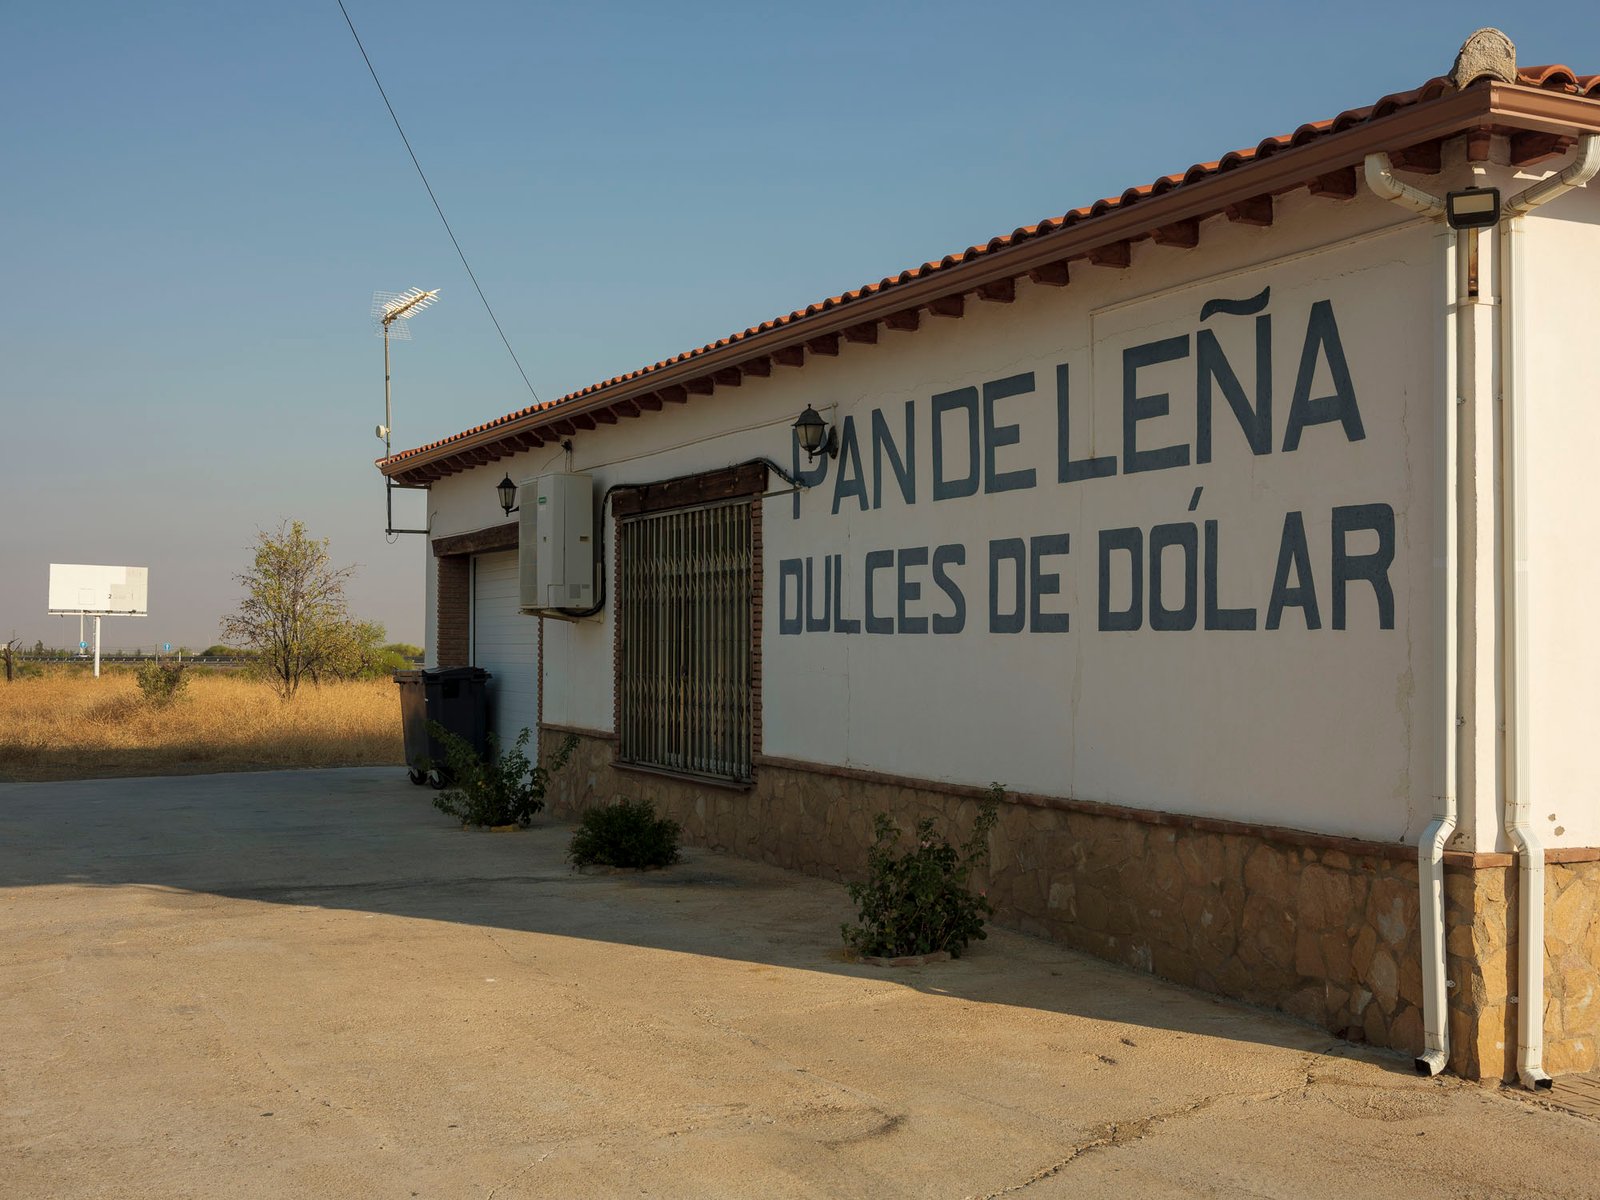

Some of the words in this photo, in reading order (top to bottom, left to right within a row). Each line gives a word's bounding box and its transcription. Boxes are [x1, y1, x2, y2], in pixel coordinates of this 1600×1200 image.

[792, 400, 916, 520] PAN
[931, 372, 1037, 502] DE
[1056, 285, 1366, 484] LEÑA
[779, 543, 966, 635] DULCES
[989, 533, 1070, 634] DE
[1098, 486, 1396, 632] DÓLAR
